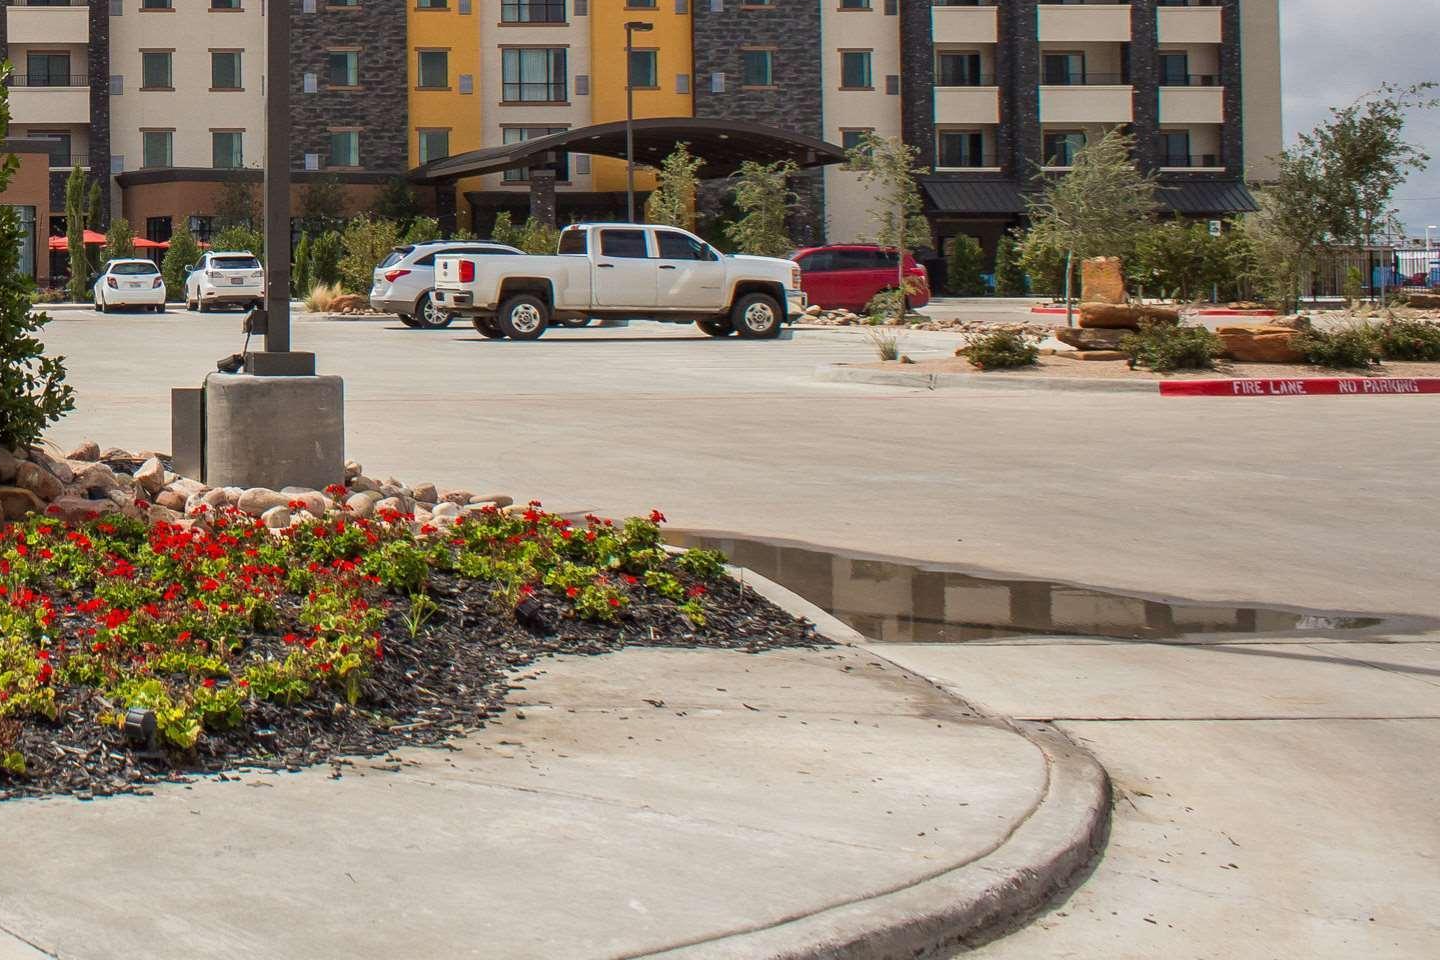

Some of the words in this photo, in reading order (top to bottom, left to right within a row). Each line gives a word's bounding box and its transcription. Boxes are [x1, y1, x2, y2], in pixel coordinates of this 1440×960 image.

[1232, 380, 1264, 395] FIRE
[1269, 380, 1307, 395] LANE
[1338, 379, 1357, 393] NO
[1363, 378, 1420, 393] PARKING
